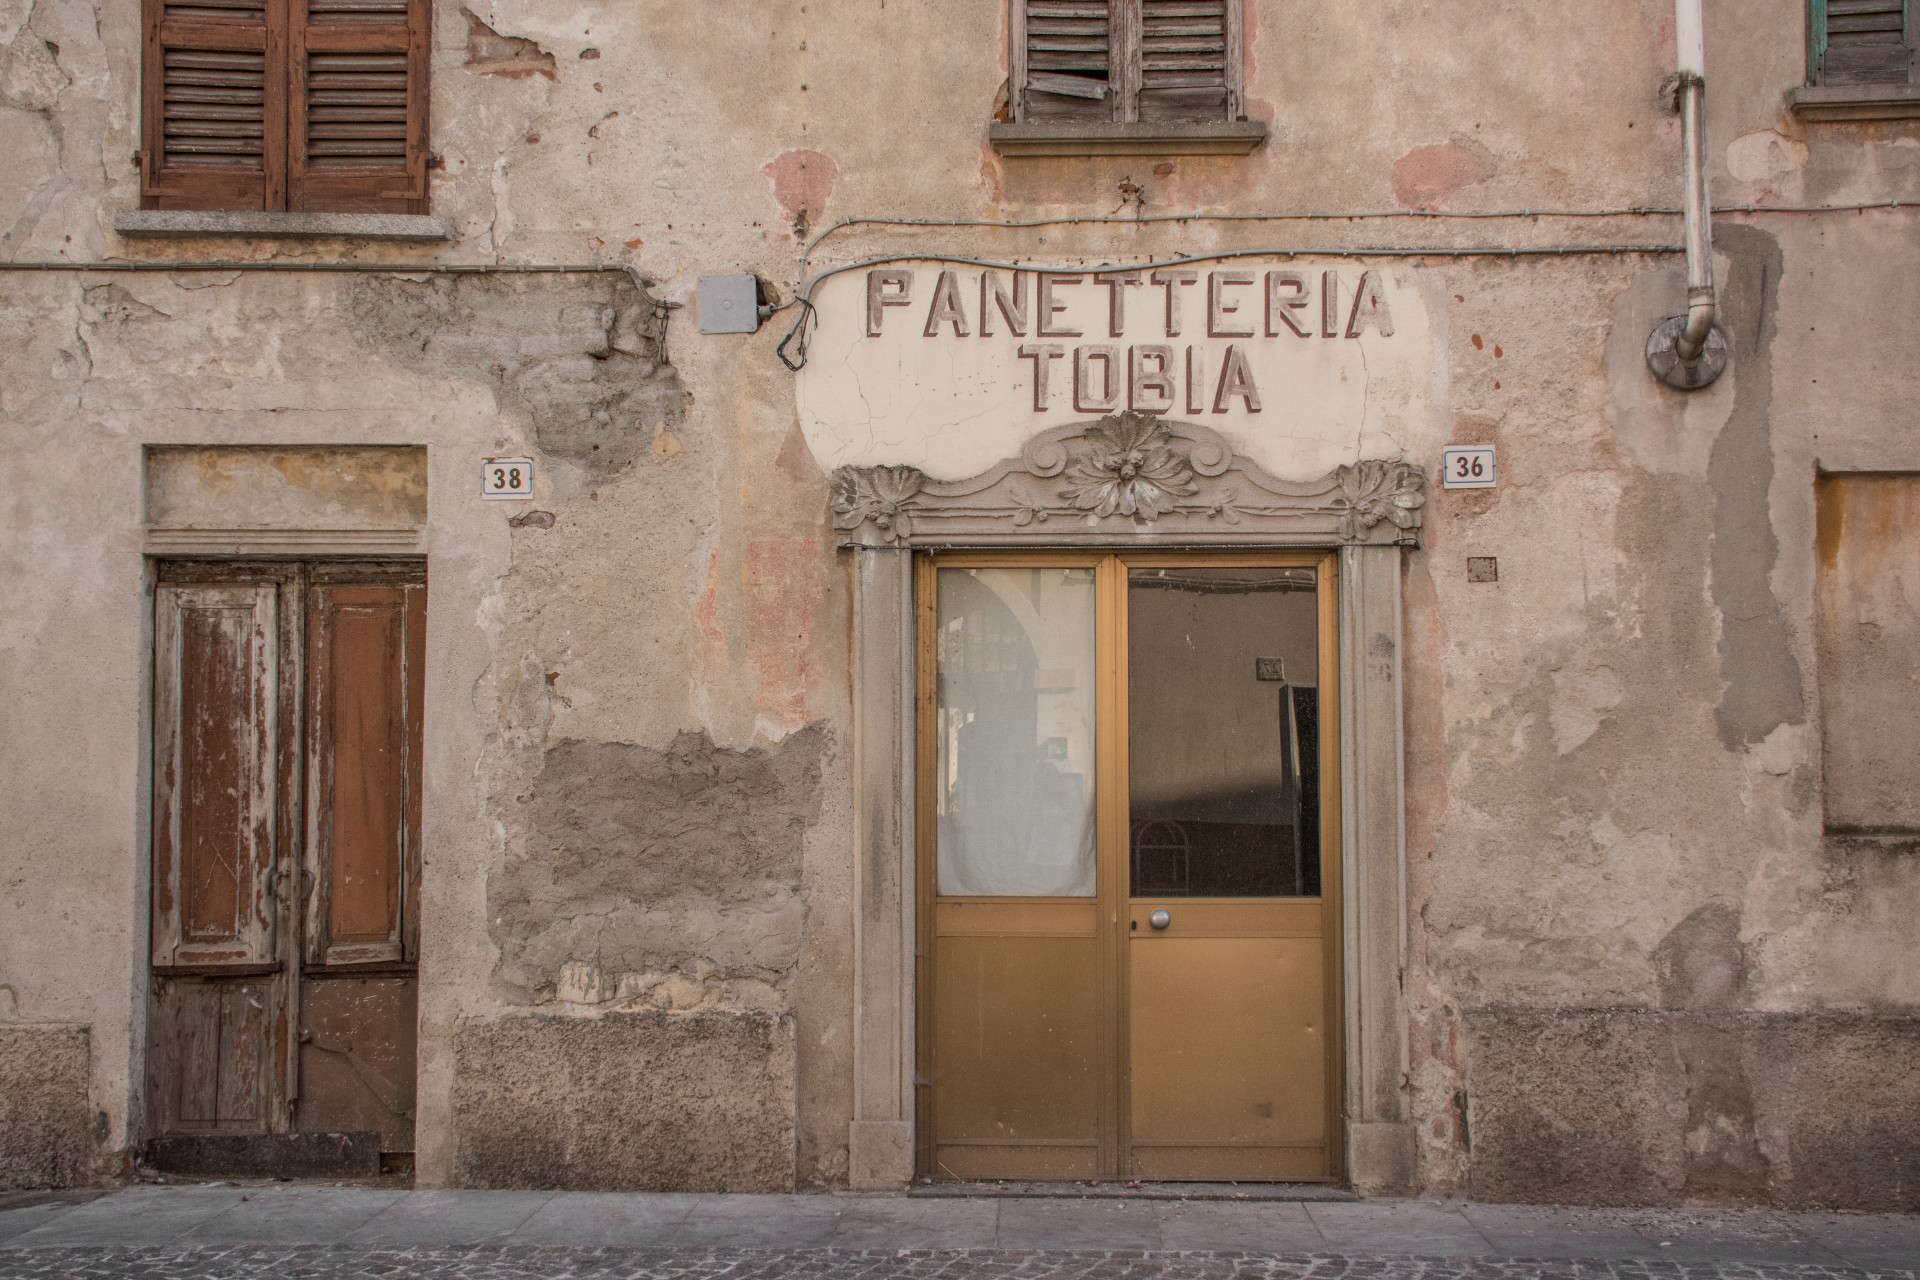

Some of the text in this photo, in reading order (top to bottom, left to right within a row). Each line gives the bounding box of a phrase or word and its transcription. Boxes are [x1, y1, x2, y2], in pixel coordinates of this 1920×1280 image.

[867, 269, 1396, 338] PANETTERIA
[1017, 343, 1263, 415] TOBIA
[493, 467, 522, 490] 38
[1456, 456, 1483, 478] 36
